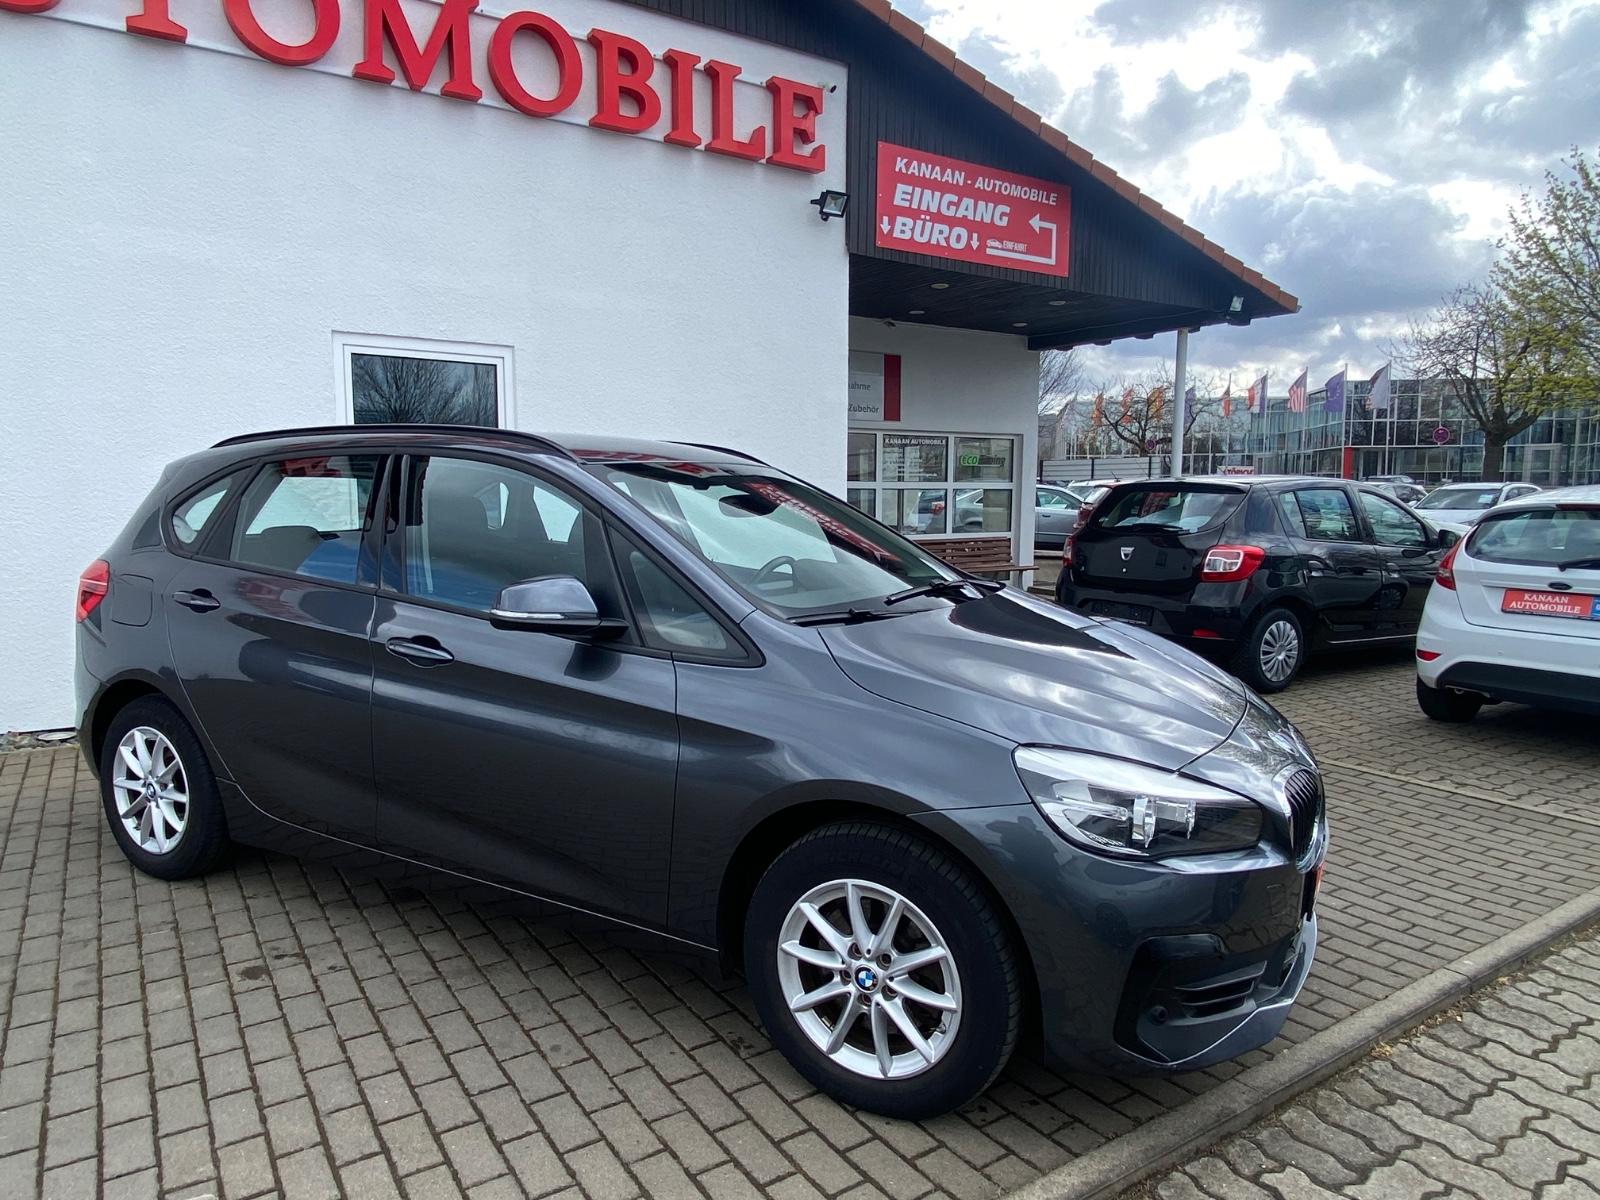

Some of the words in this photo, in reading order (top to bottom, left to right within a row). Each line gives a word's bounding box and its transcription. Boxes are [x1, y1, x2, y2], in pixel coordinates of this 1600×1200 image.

[895, 157, 966, 186] KANAAN
[974, 176, 1059, 206] AUTOMOBILE
[893, 183, 1011, 227] EINGANG
[892, 214, 968, 250] BÜRO
[1509, 601, 1581, 614] AUTOMOBILE
[1523, 593, 1569, 604] KANAAN
